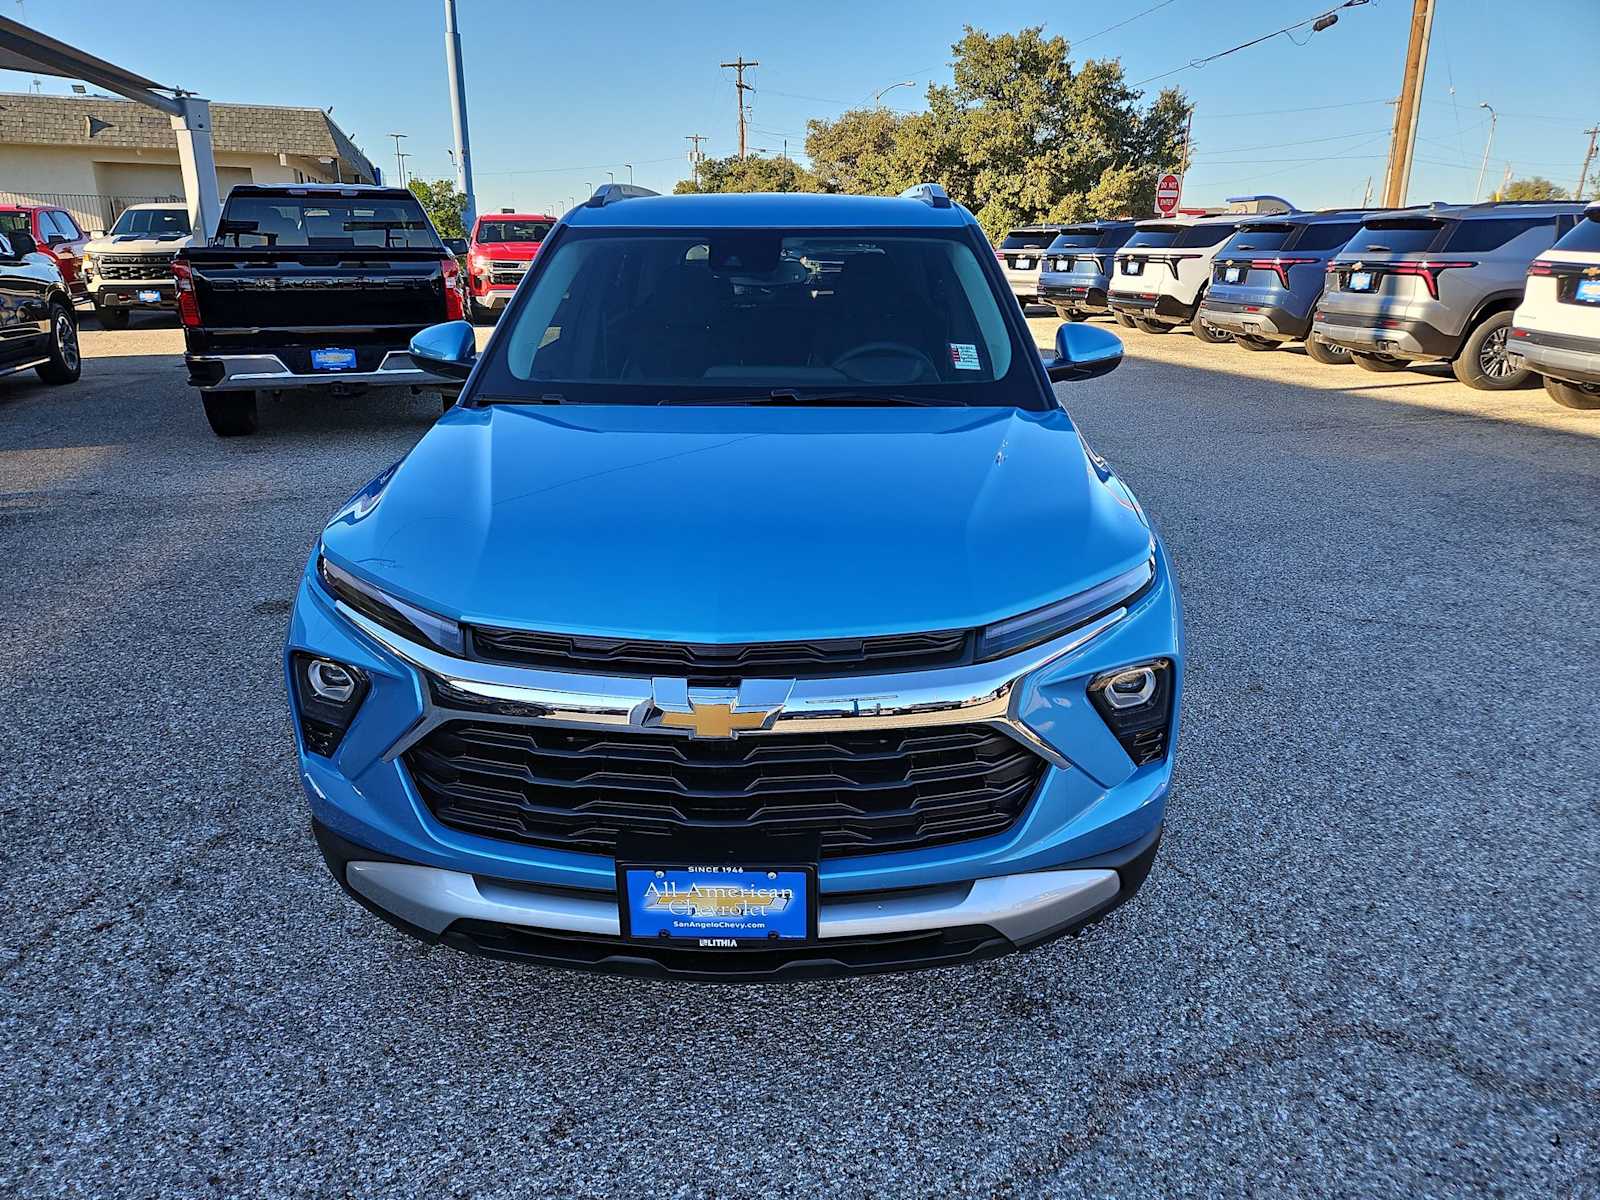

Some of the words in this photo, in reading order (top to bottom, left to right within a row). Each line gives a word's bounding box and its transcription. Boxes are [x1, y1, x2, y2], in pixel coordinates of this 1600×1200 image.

[644, 881, 677, 898] All
[686, 882, 794, 899] American
[668, 899, 769, 917] Chevrolet
[673, 920, 766, 929] SanAngeloChevy.com
[708, 939, 738, 948] LITHIA
